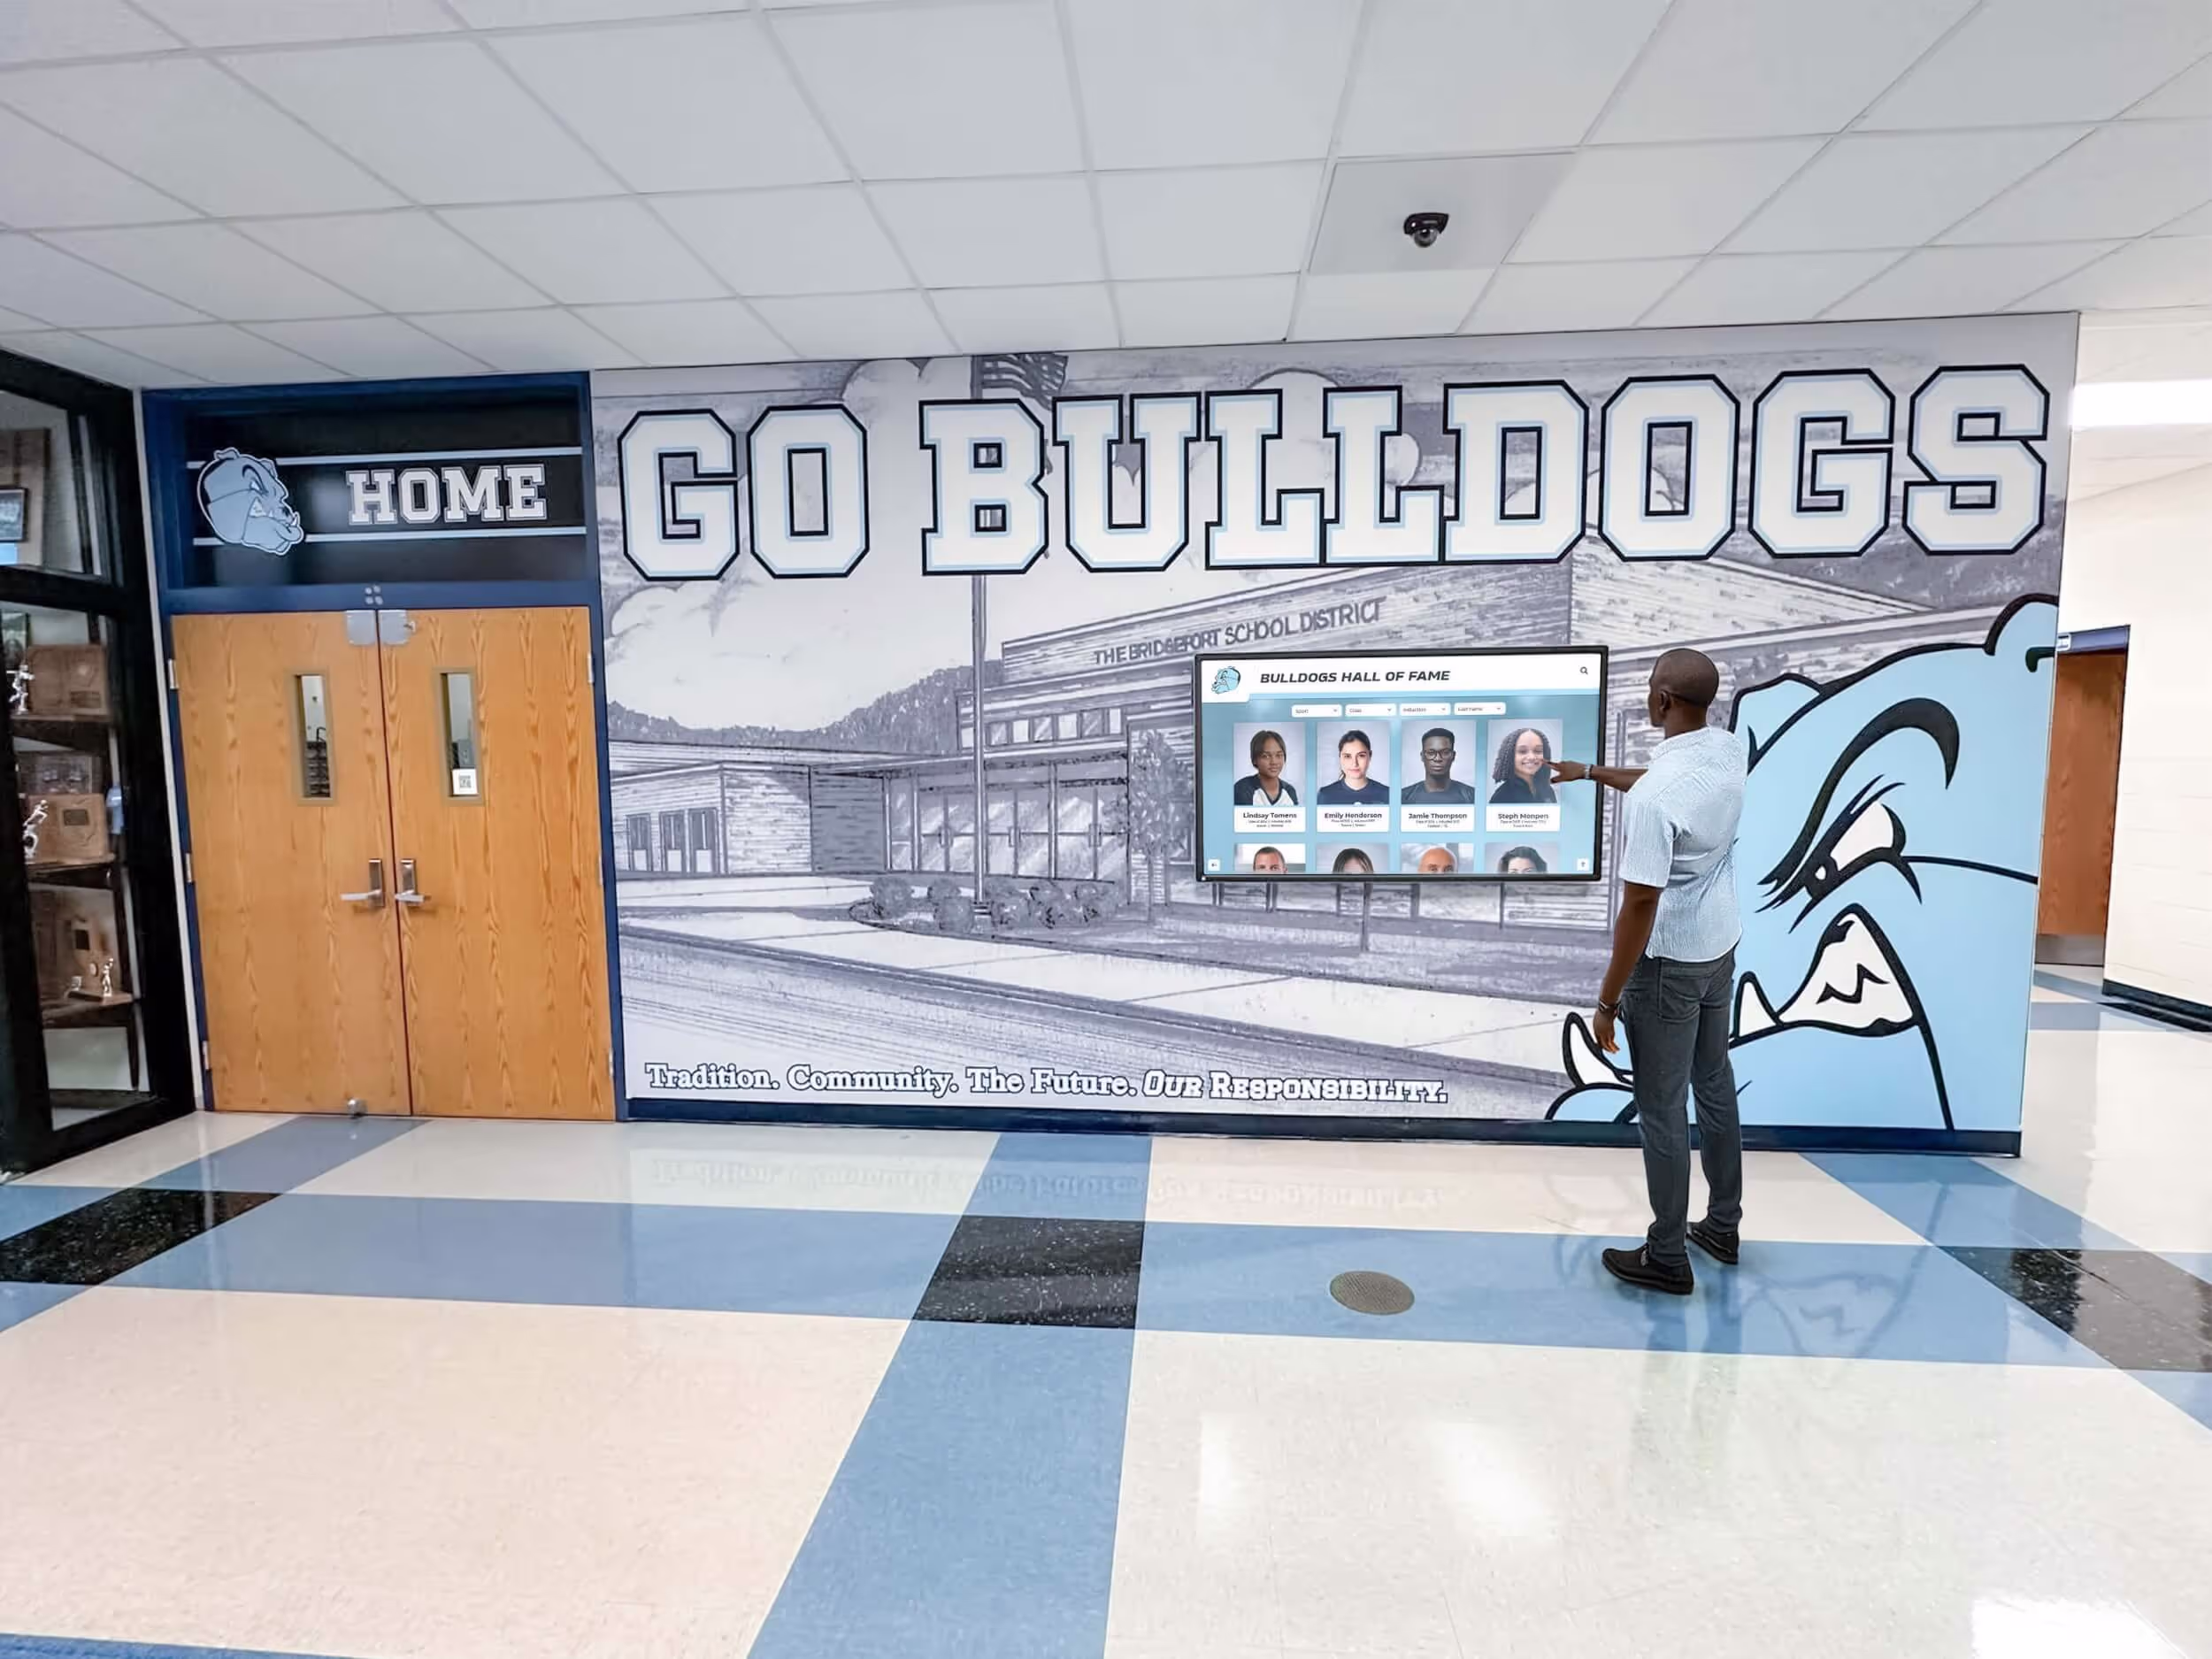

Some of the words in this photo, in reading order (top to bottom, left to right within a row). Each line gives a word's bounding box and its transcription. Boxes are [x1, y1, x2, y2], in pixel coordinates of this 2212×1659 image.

[345, 464, 547, 526] HOME
[617, 403, 871, 581] GO
[918, 364, 2051, 576] BULLDOGS
[1094, 645, 1127, 664] THE
[1225, 616, 1299, 645] SCHOOL
[1300, 595, 1387, 634] DISTRICT
[1260, 672, 1338, 683] BULLDOGS
[1341, 672, 1381, 682] HALL
[1385, 671, 1405, 681] OF
[1409, 670, 1451, 681] FAME
[645, 1063, 780, 1089] Tradition.
[787, 1064, 959, 1098] Community.
[965, 1066, 1025, 1094] The
[1031, 1067, 1138, 1096] Future.
[1141, 1069, 1204, 1098] OUR
[1209, 1071, 1448, 1103] RESPONSIBILITY.
